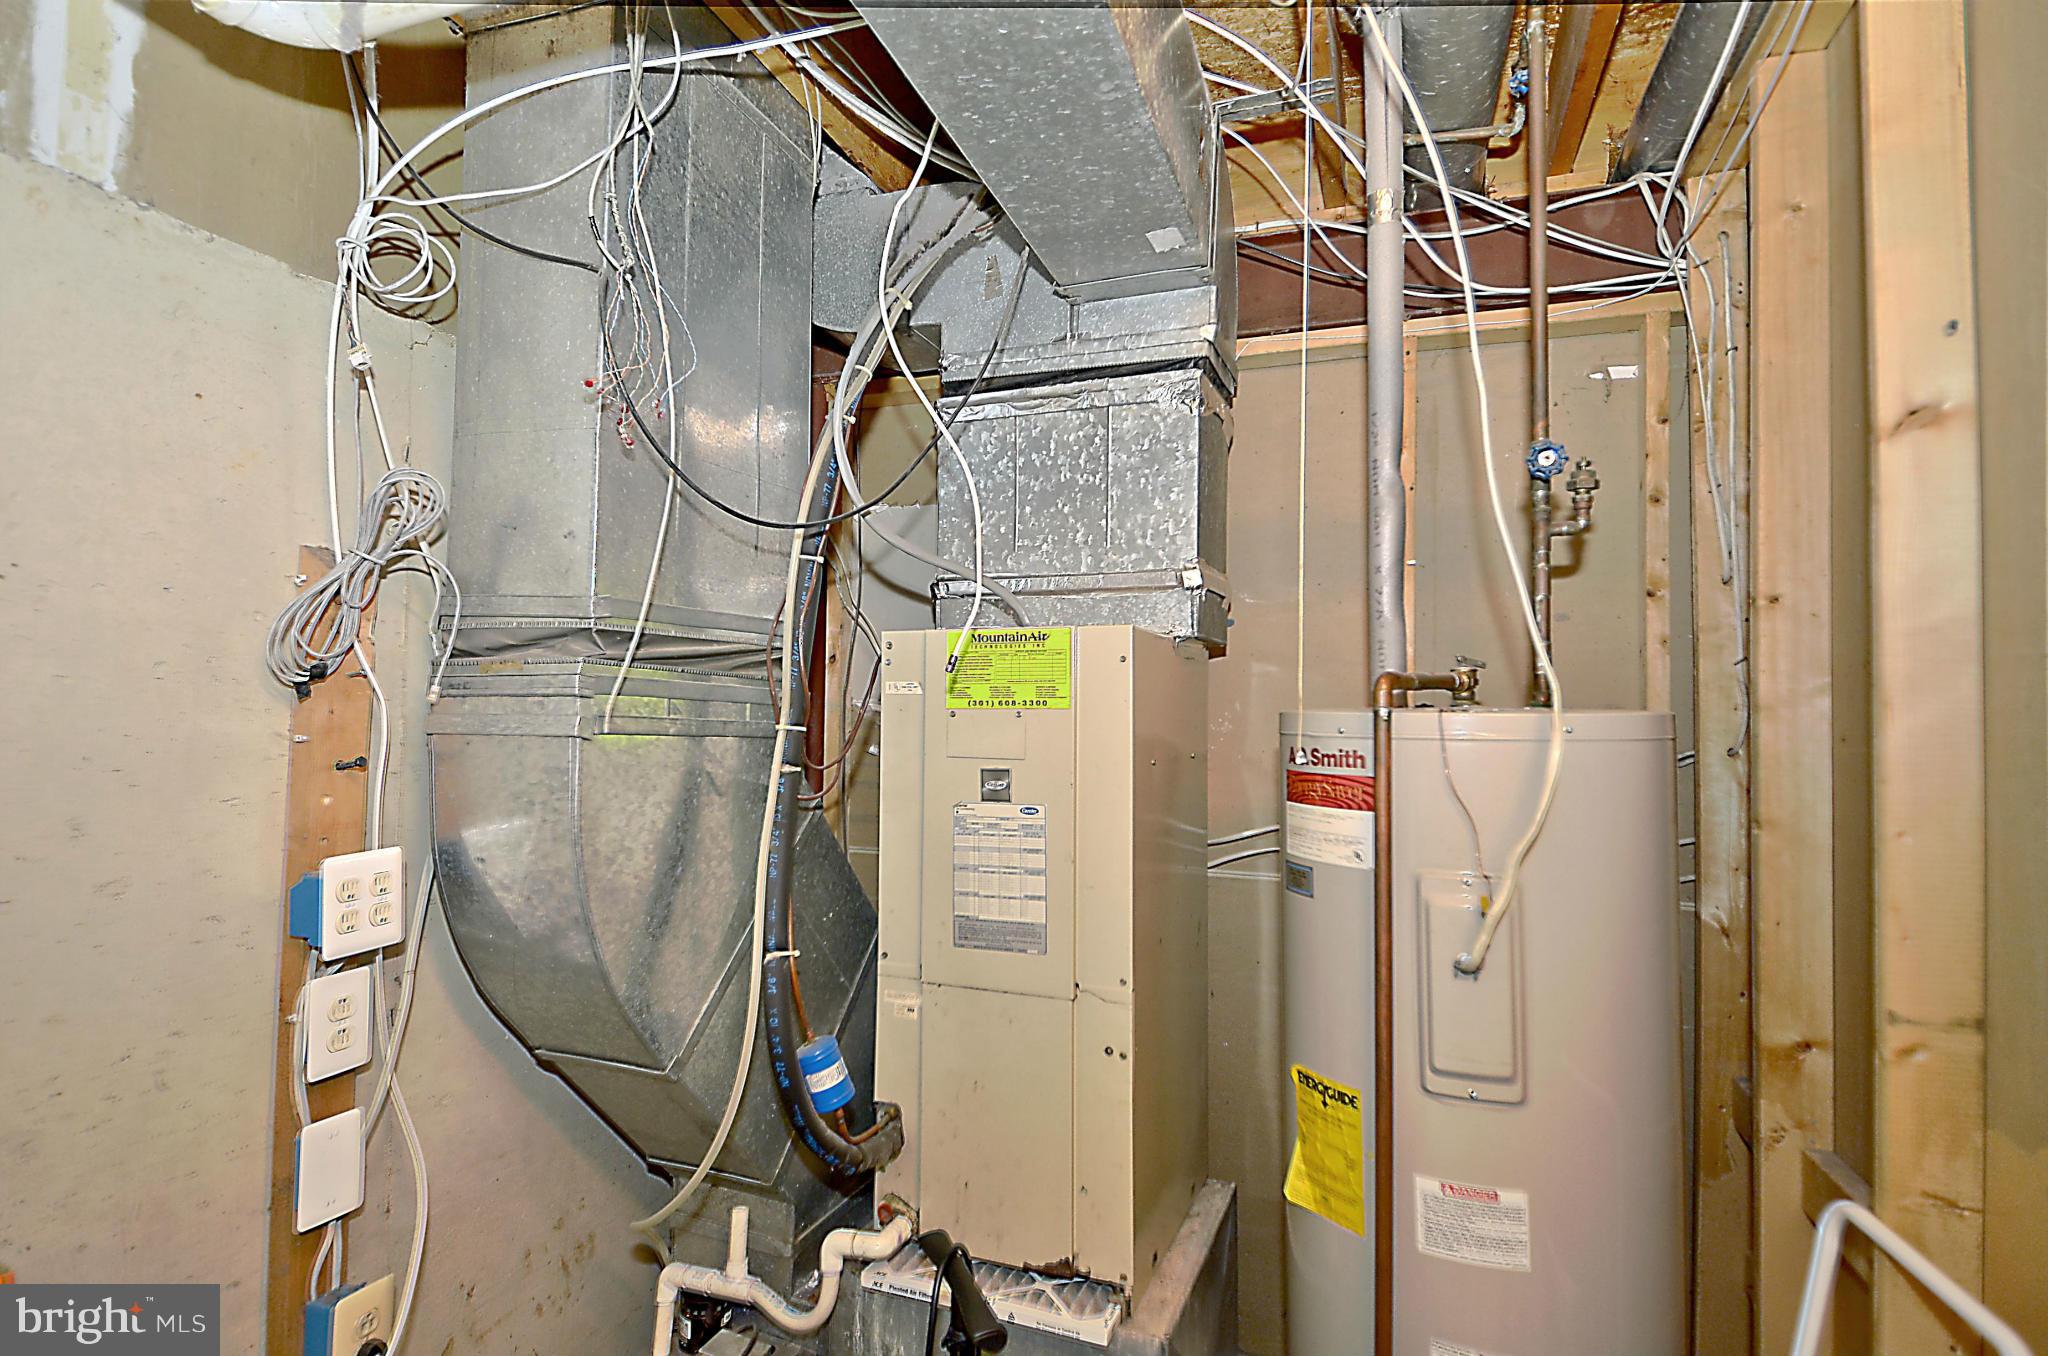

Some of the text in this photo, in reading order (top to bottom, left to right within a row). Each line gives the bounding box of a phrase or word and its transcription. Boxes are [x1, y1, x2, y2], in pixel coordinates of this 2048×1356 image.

[970, 631, 1050, 644] MountainAir
[967, 699, 1048, 708] (301) 608-3300
